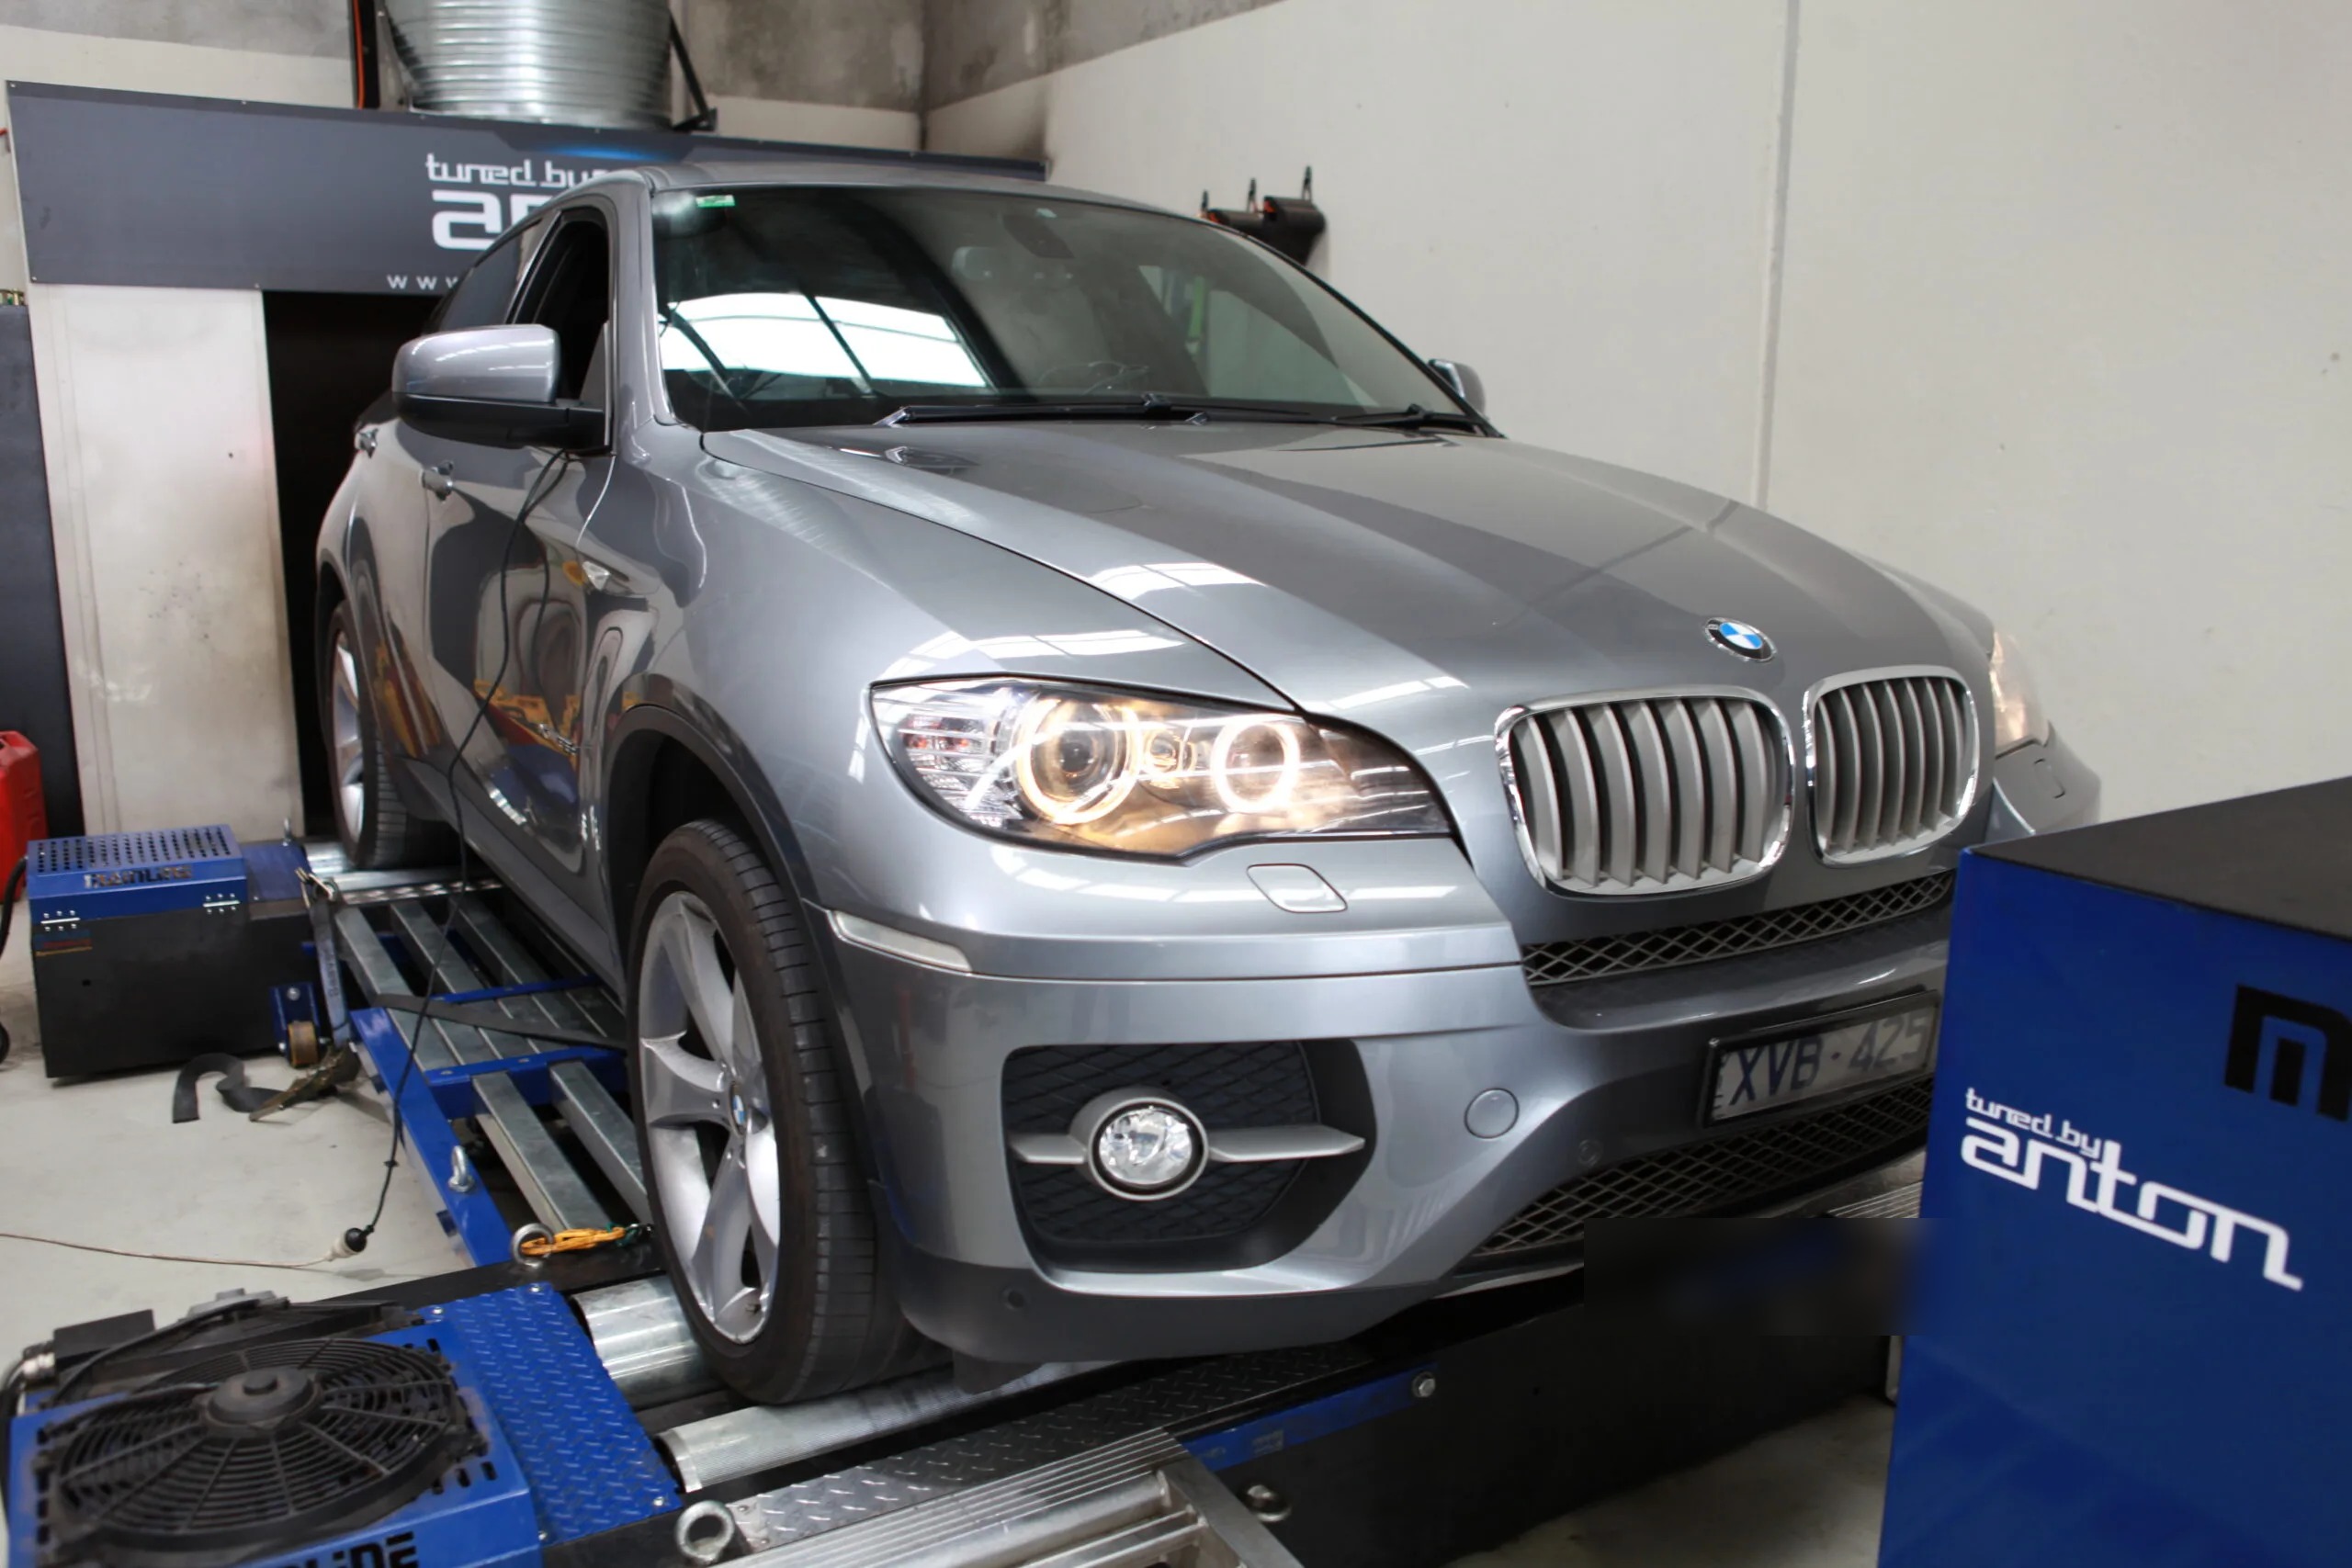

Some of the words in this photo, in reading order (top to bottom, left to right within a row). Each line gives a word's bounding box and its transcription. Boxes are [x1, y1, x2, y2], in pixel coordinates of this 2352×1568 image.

[1965, 1087, 2054, 1139] tuned
[2055, 1120, 2102, 1160] by
[1961, 1116, 2303, 1292] anton
